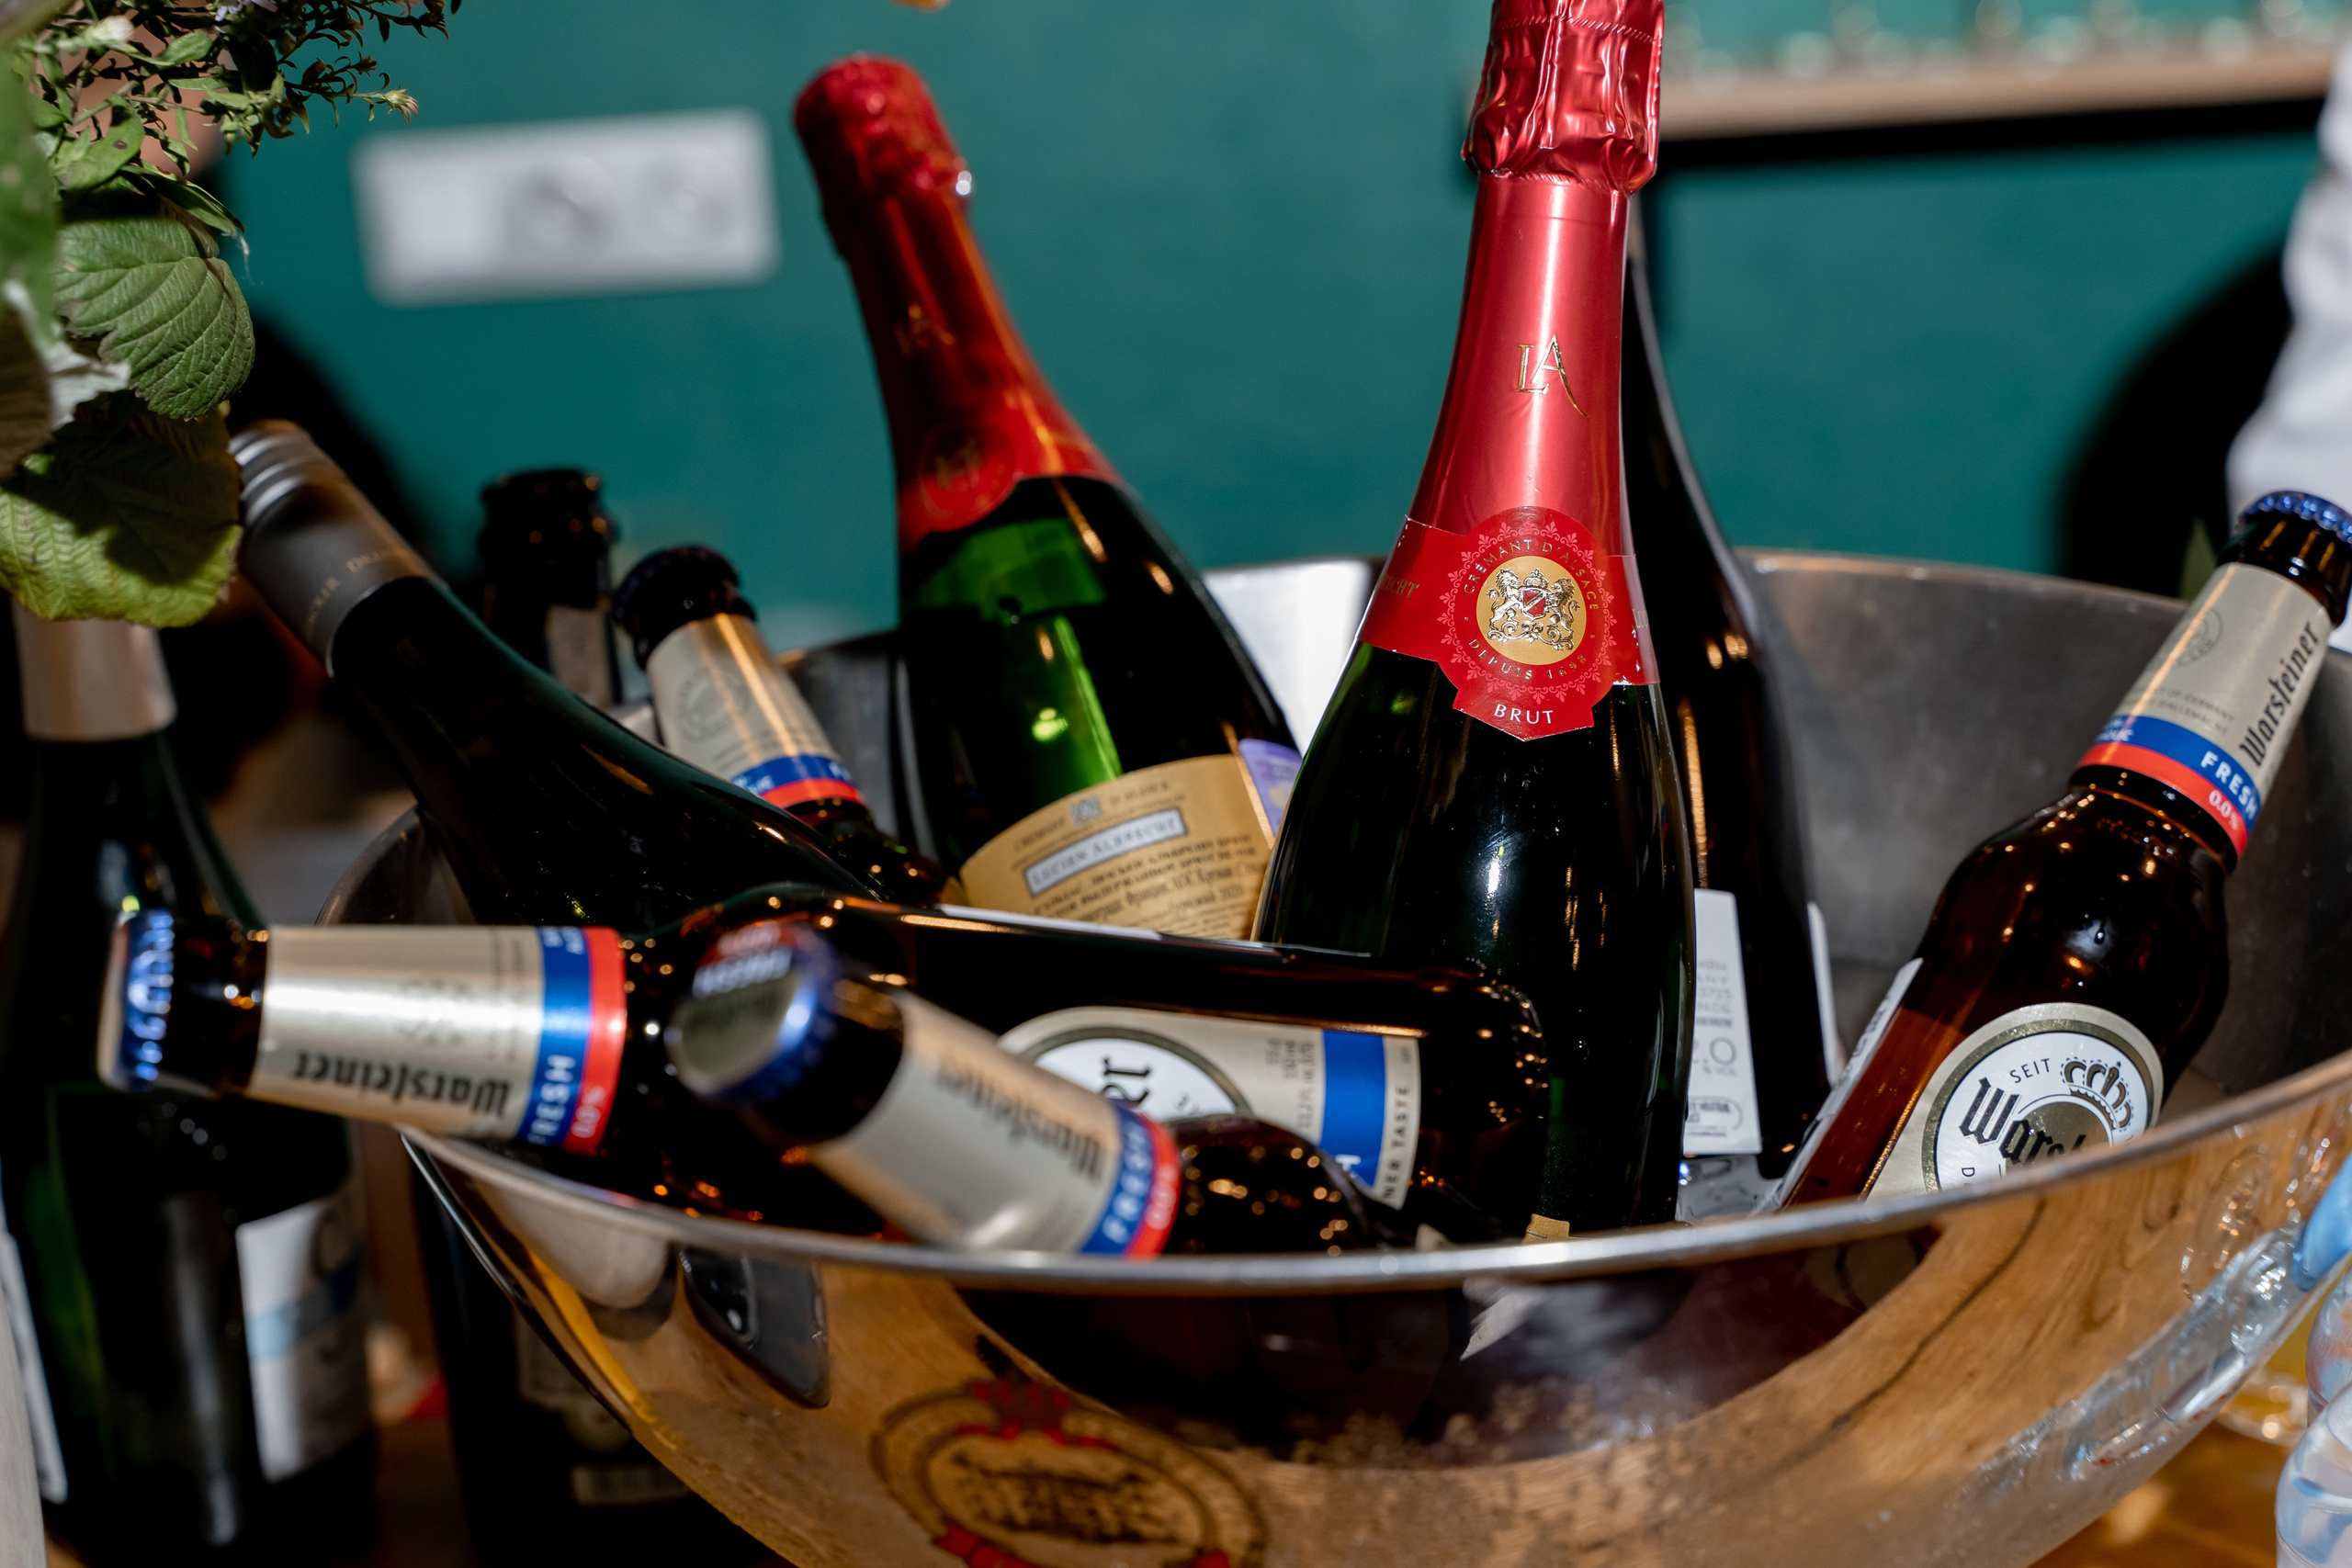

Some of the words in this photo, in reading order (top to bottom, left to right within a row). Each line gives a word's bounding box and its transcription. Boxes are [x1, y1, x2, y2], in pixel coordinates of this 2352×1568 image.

[1515, 334, 1588, 417] LA
[1468, 639, 1532, 680] DEPUIS
[1494, 703, 1554, 725] BRUT
[2239, 620, 2319, 768] Warsteiner
[2200, 750, 2258, 820] FRESH
[291, 1050, 511, 1118] Warsteiner
[2009, 1058, 2051, 1084] SEIT
